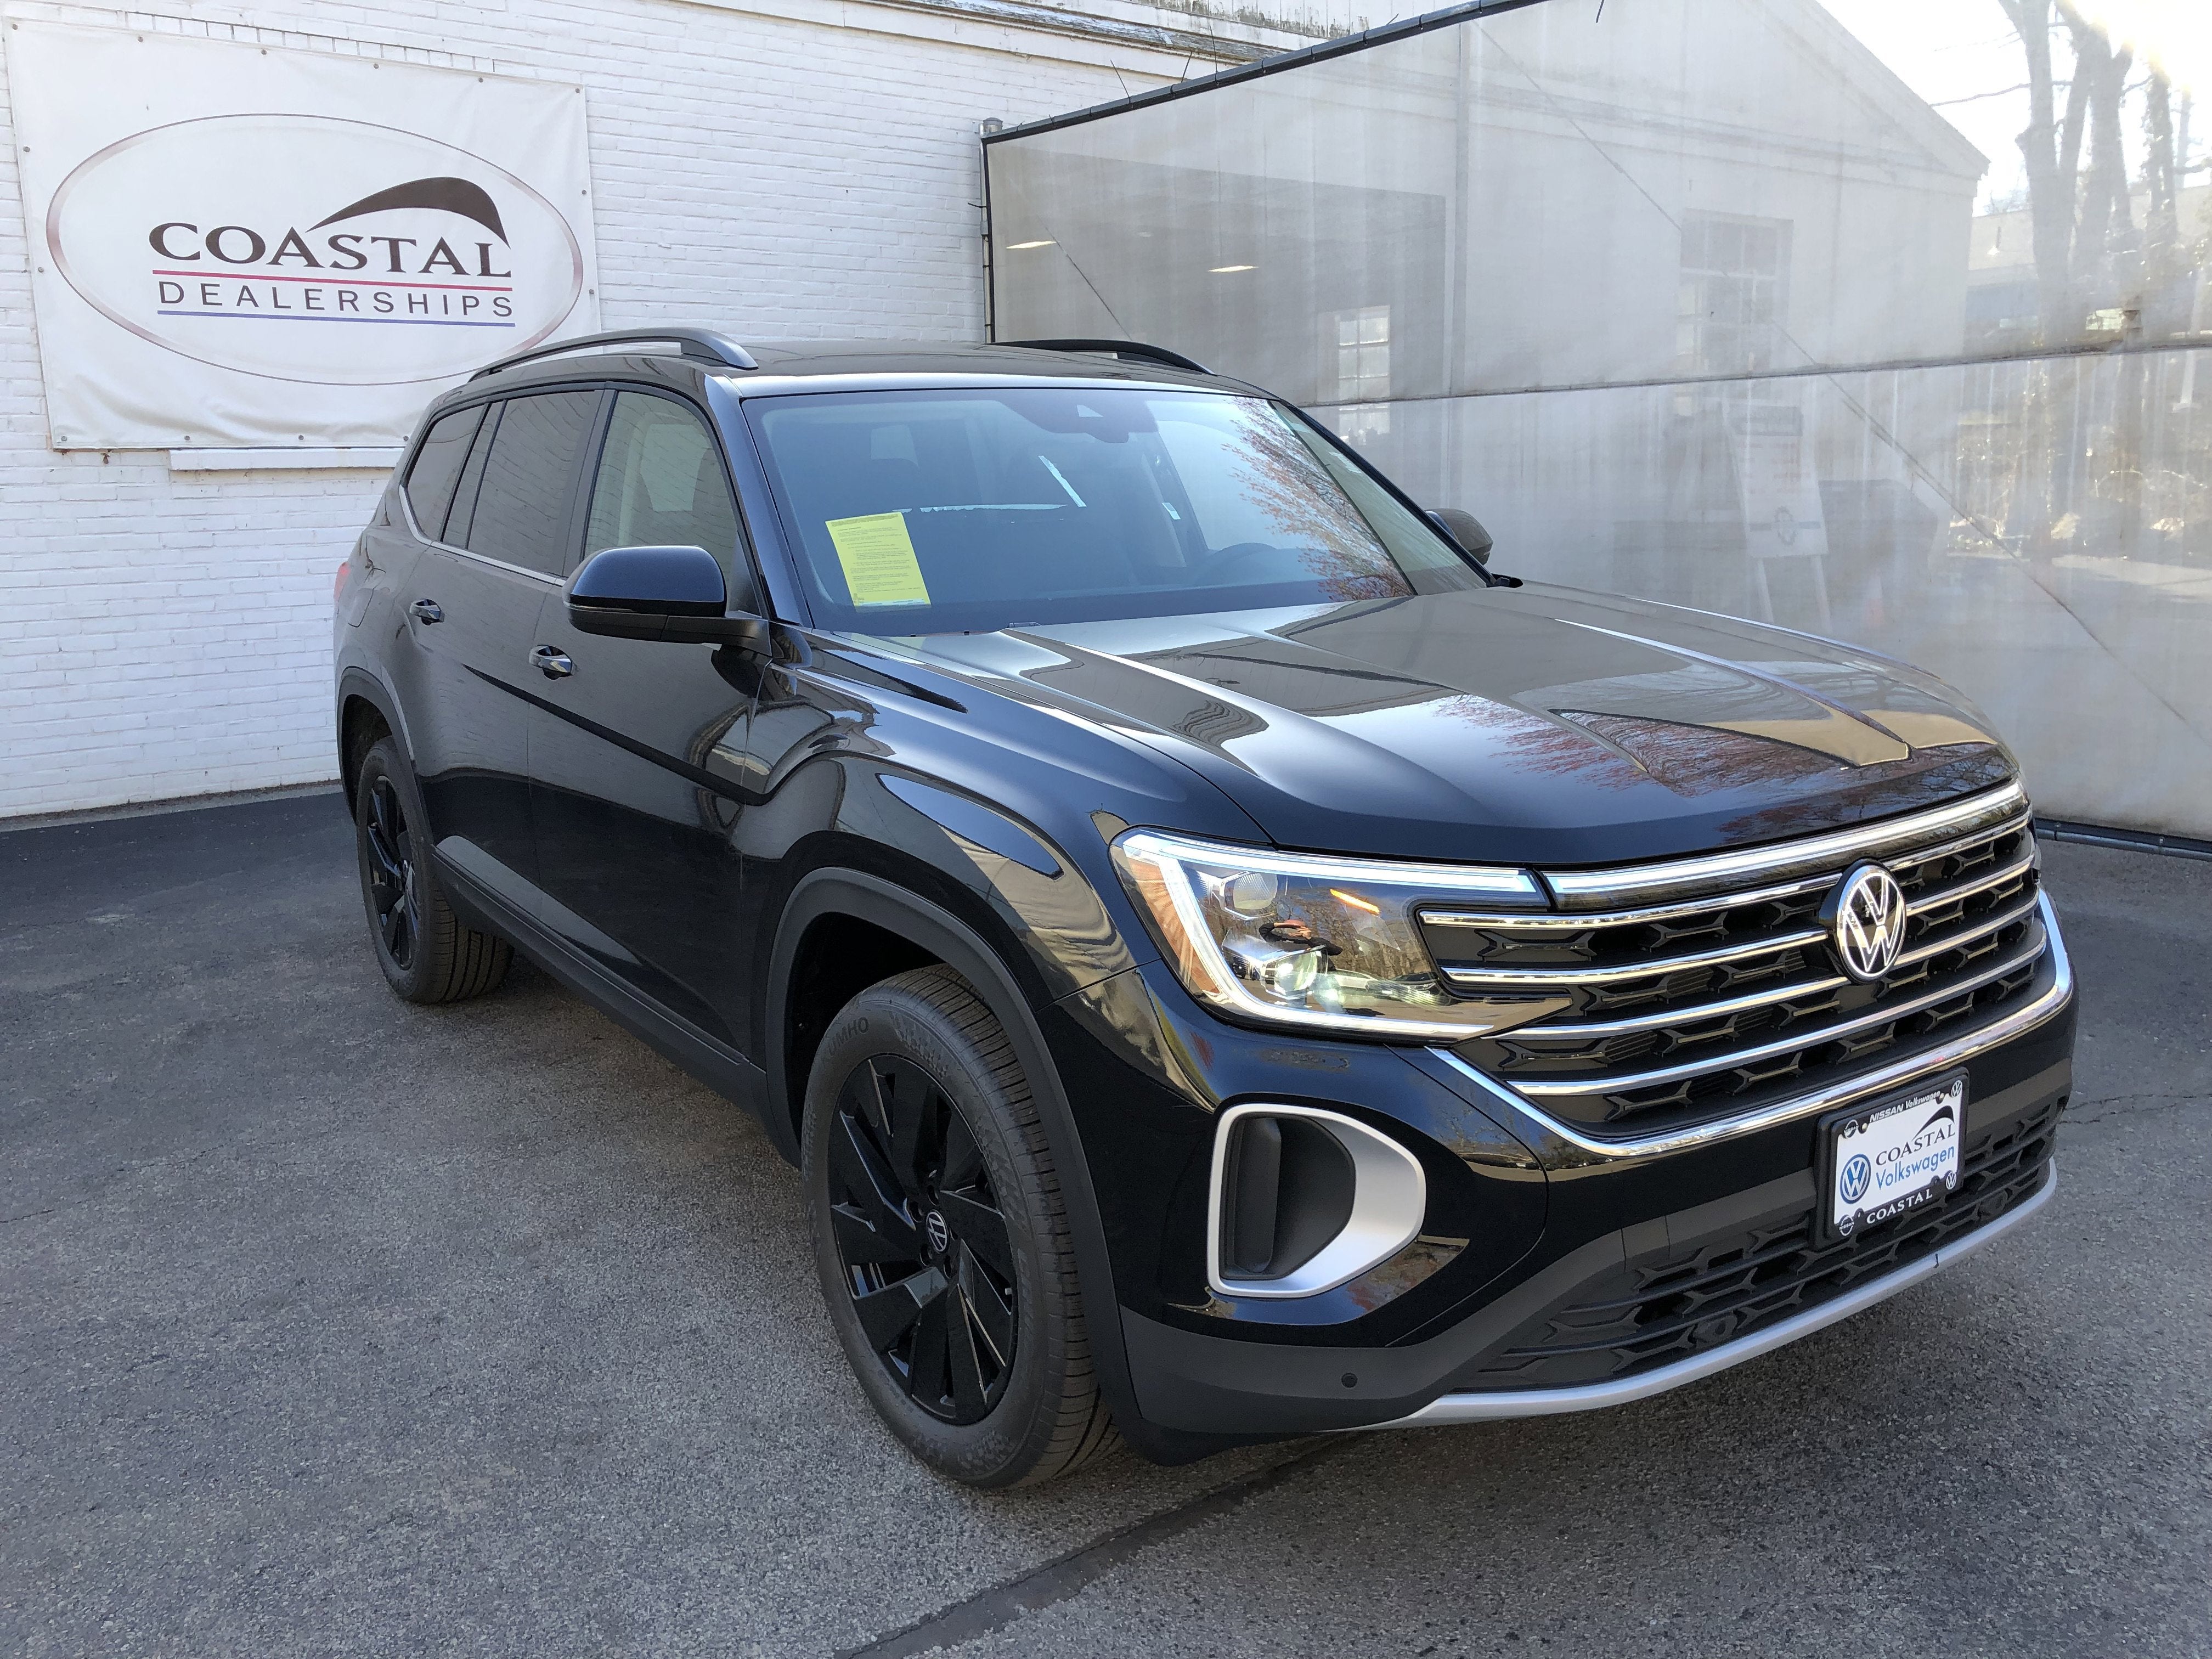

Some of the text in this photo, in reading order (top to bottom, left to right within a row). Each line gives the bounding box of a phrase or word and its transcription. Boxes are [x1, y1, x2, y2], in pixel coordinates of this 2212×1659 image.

[149, 222, 511, 278] COASTAL
[158, 280, 513, 317] DEALERSHIPS
[1844, 874, 1904, 971] VW
[821, 1017, 869, 1067] UMHO
[1870, 1091, 1940, 1123] NISSAN Volkswagen
[1876, 1124, 1955, 1166] COASTAL
[1842, 1156, 1869, 1202] VW
[1876, 1146, 1954, 1190] Volkswagen
[1866, 1188, 1933, 1224] COASTAL
